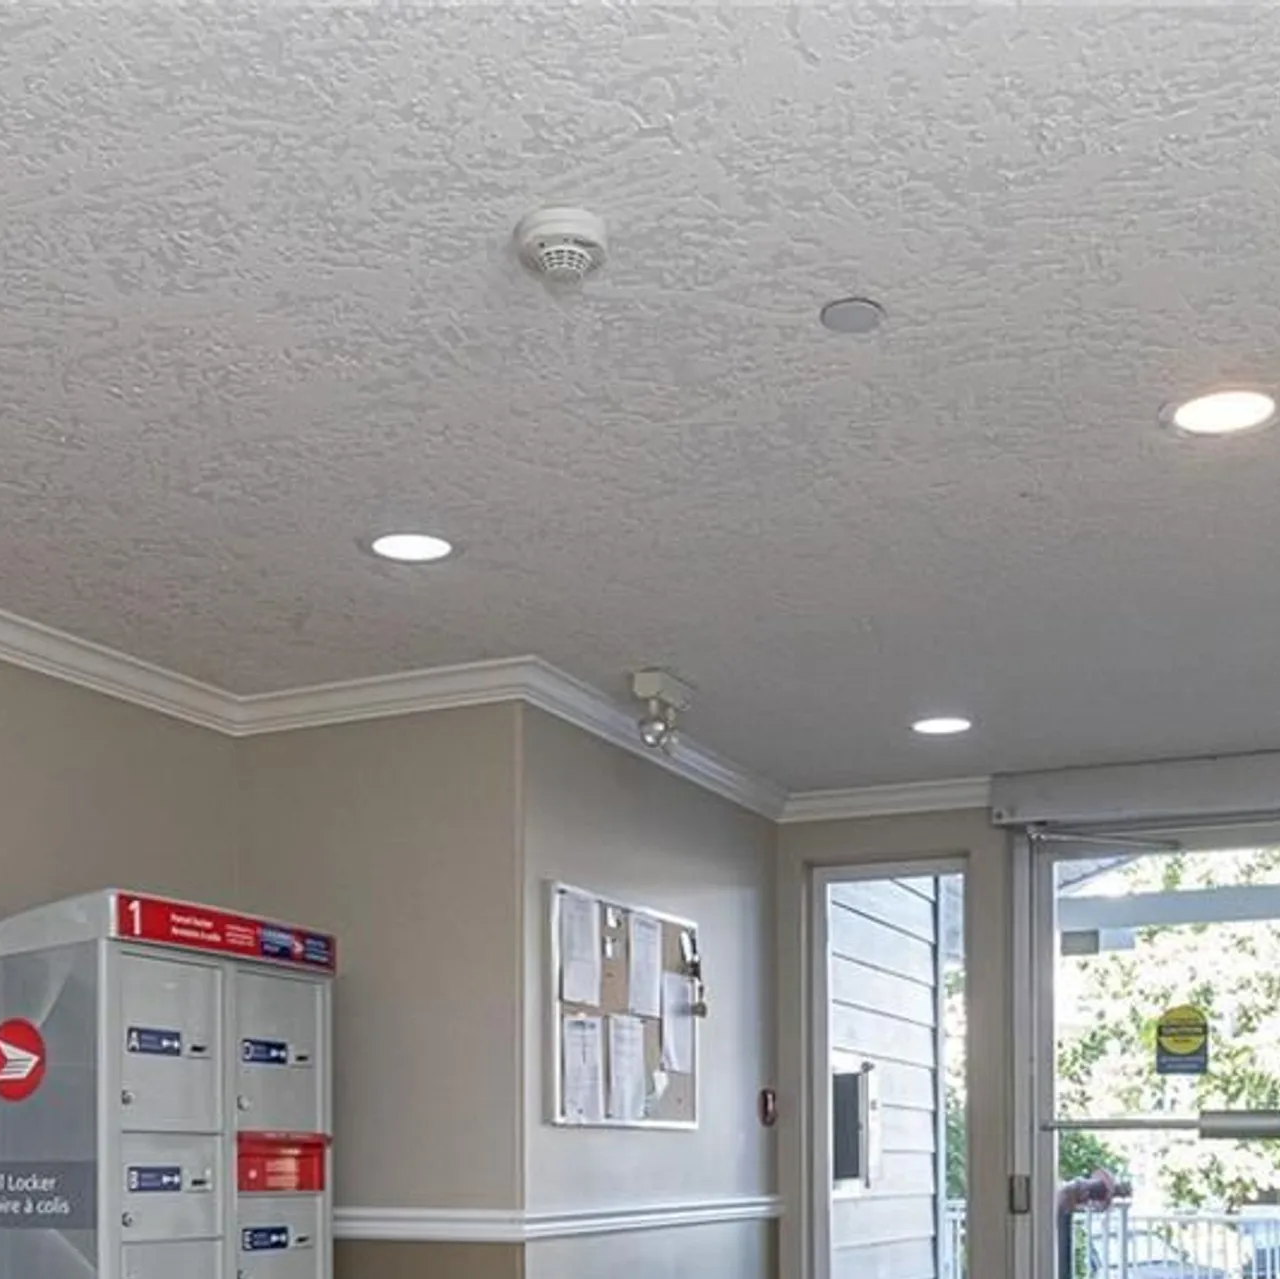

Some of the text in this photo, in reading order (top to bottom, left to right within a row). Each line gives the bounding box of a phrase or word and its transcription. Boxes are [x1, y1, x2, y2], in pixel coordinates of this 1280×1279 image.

[128, 899, 141, 935] 1
[128, 1030, 140, 1051] A
[7, 1173, 56, 1192] Locker
[35, 1196, 70, 1215] colis
